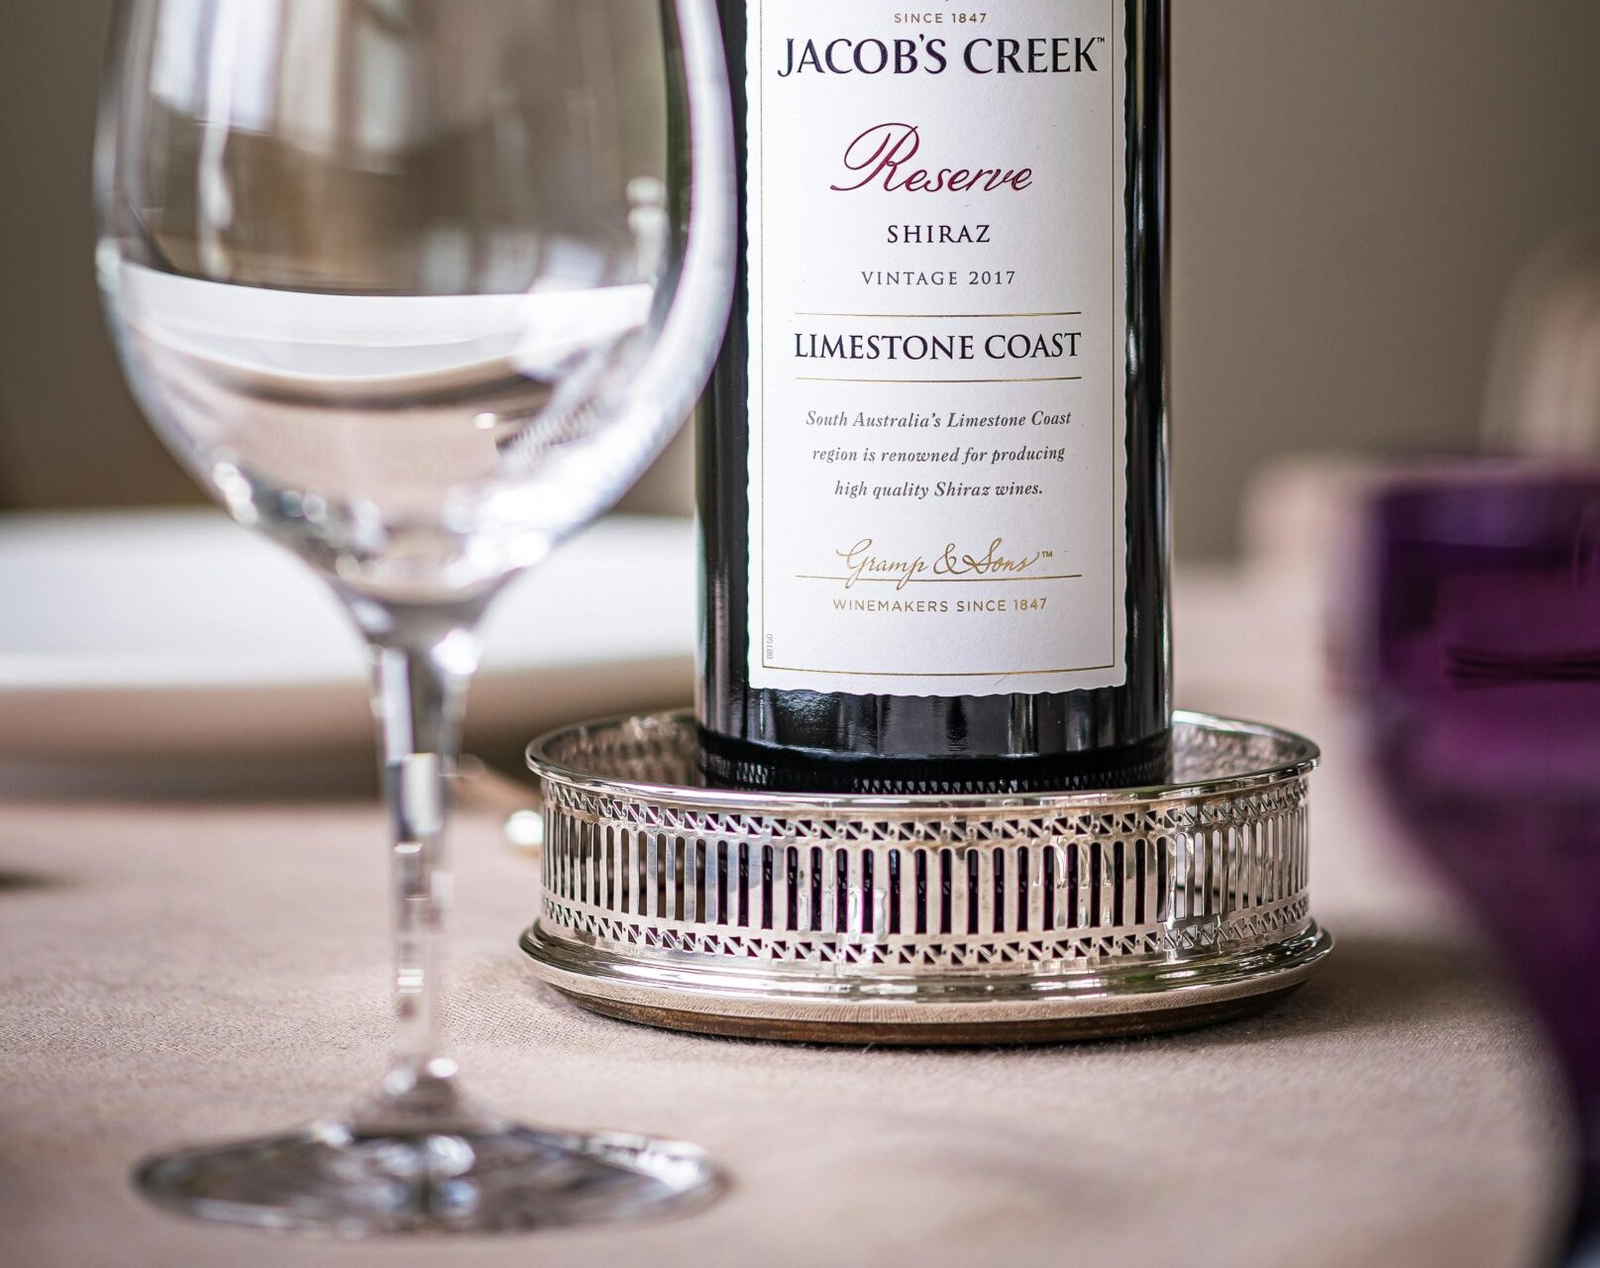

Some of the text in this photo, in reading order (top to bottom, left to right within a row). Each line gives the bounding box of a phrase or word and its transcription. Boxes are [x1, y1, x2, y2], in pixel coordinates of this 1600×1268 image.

[894, 12, 987, 24] SINCE 1847
[776, 33, 948, 78] JACOB'S
[829, 122, 1034, 193] Reserve
[886, 223, 991, 244] SHIRAZ
[860, 270, 1016, 286] VINTAGE 2017
[794, 331, 1083, 361] LIMESTONE COAST
[805, 409, 1072, 429] South Australia's Limestone Coast
[812, 445, 1066, 467] region is renowned for producing
[834, 479, 1043, 500] high quality Shiraz wines.
[836, 538, 929, 591] Gramp
[933, 542, 962, 575] &
[832, 597, 1048, 613] WINEMAKERS SINCE 1847
